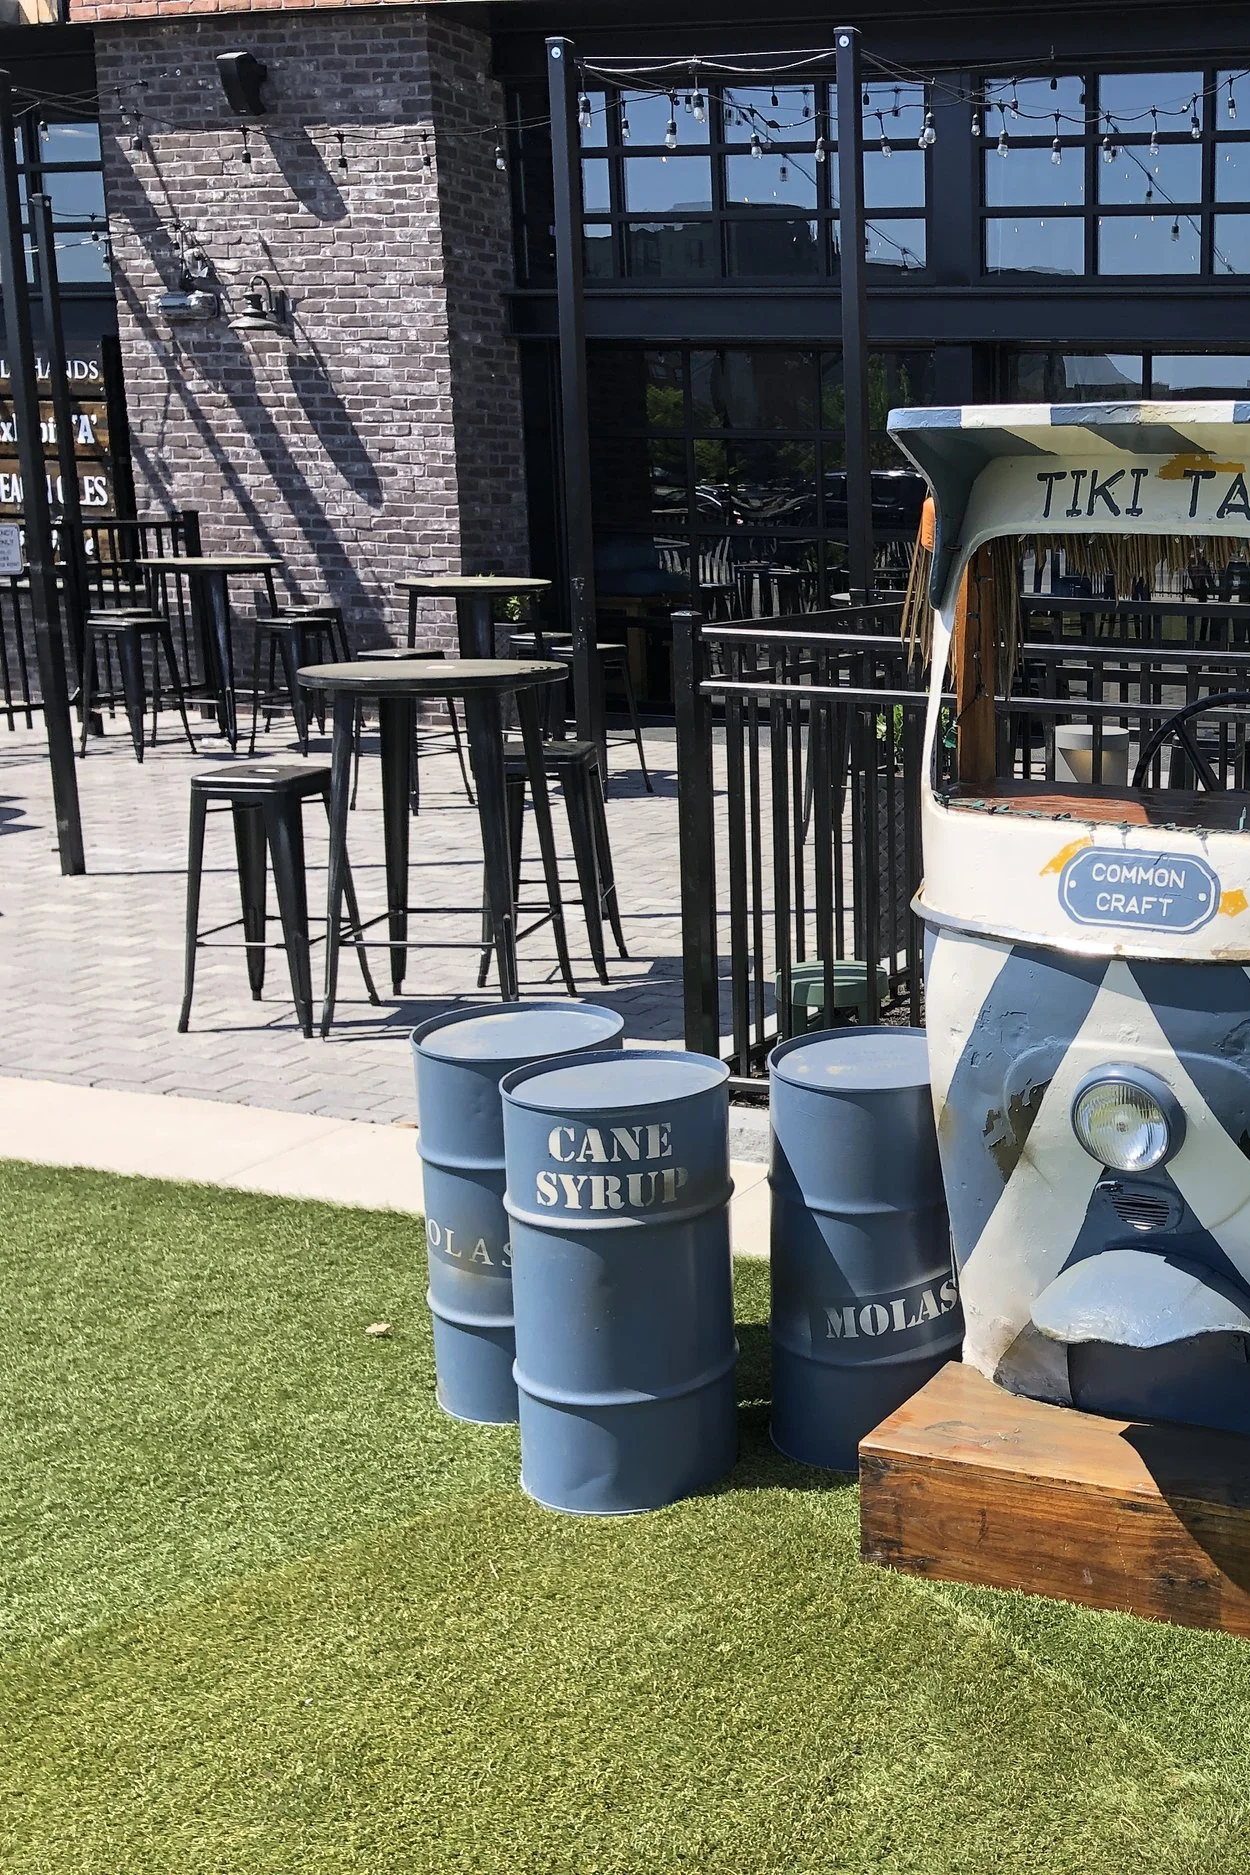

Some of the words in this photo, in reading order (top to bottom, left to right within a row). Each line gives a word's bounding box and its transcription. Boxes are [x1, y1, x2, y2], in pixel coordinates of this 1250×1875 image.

[1036, 468, 1149, 518] TIKI
[1091, 863, 1186, 889] COMMON
[1096, 892, 1173, 917] CRAFT
[548, 1122, 672, 1163] CANE
[536, 1167, 689, 1211] SYRUP
[823, 1278, 958, 1339] MOLAS
